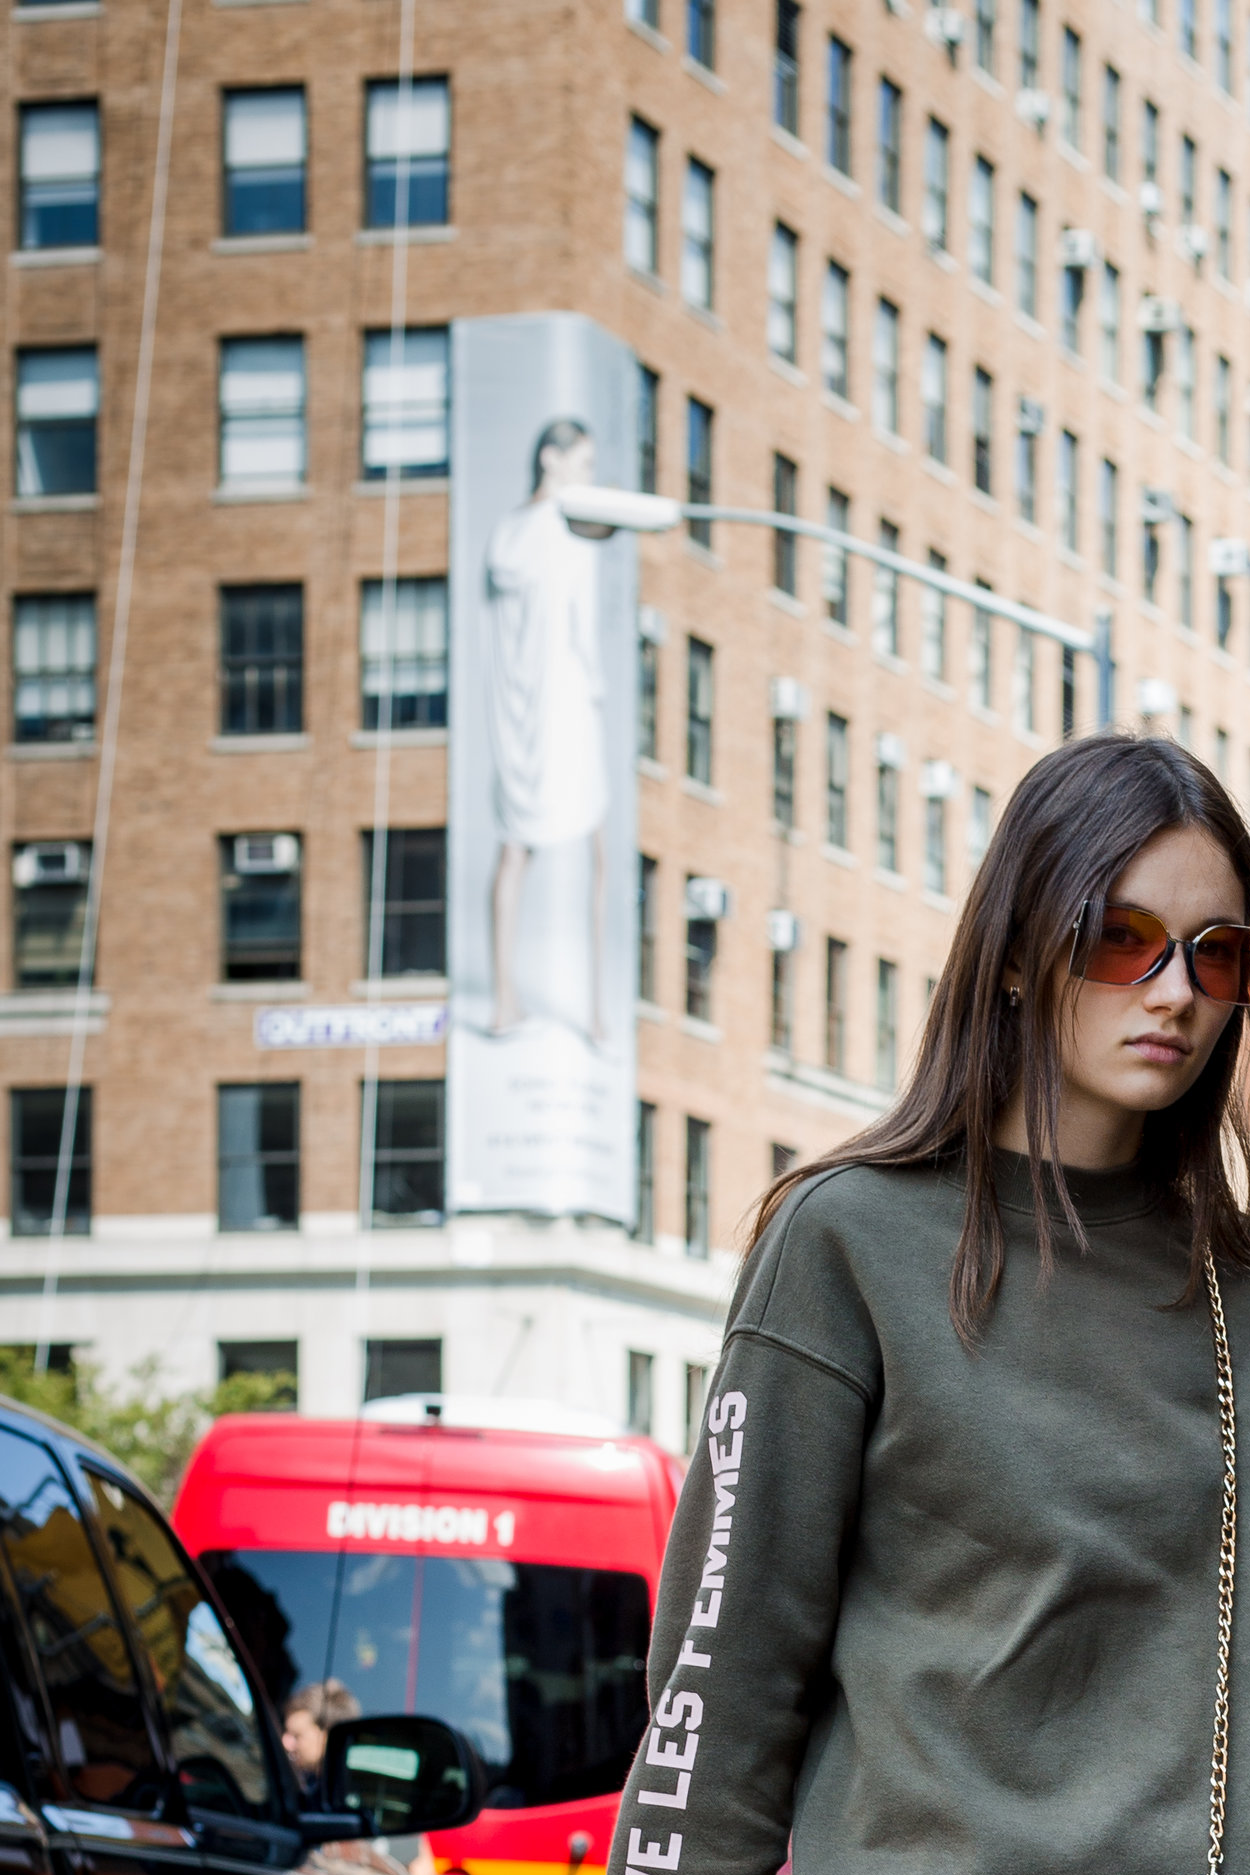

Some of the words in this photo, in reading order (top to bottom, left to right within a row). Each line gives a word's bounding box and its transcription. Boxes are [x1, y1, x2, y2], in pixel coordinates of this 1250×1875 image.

[327, 1501, 488, 1545] DIVISION
[493, 1509, 516, 1548] 1
[637, 1688, 704, 1811] LES
[677, 1389, 748, 1669] FEMMES
